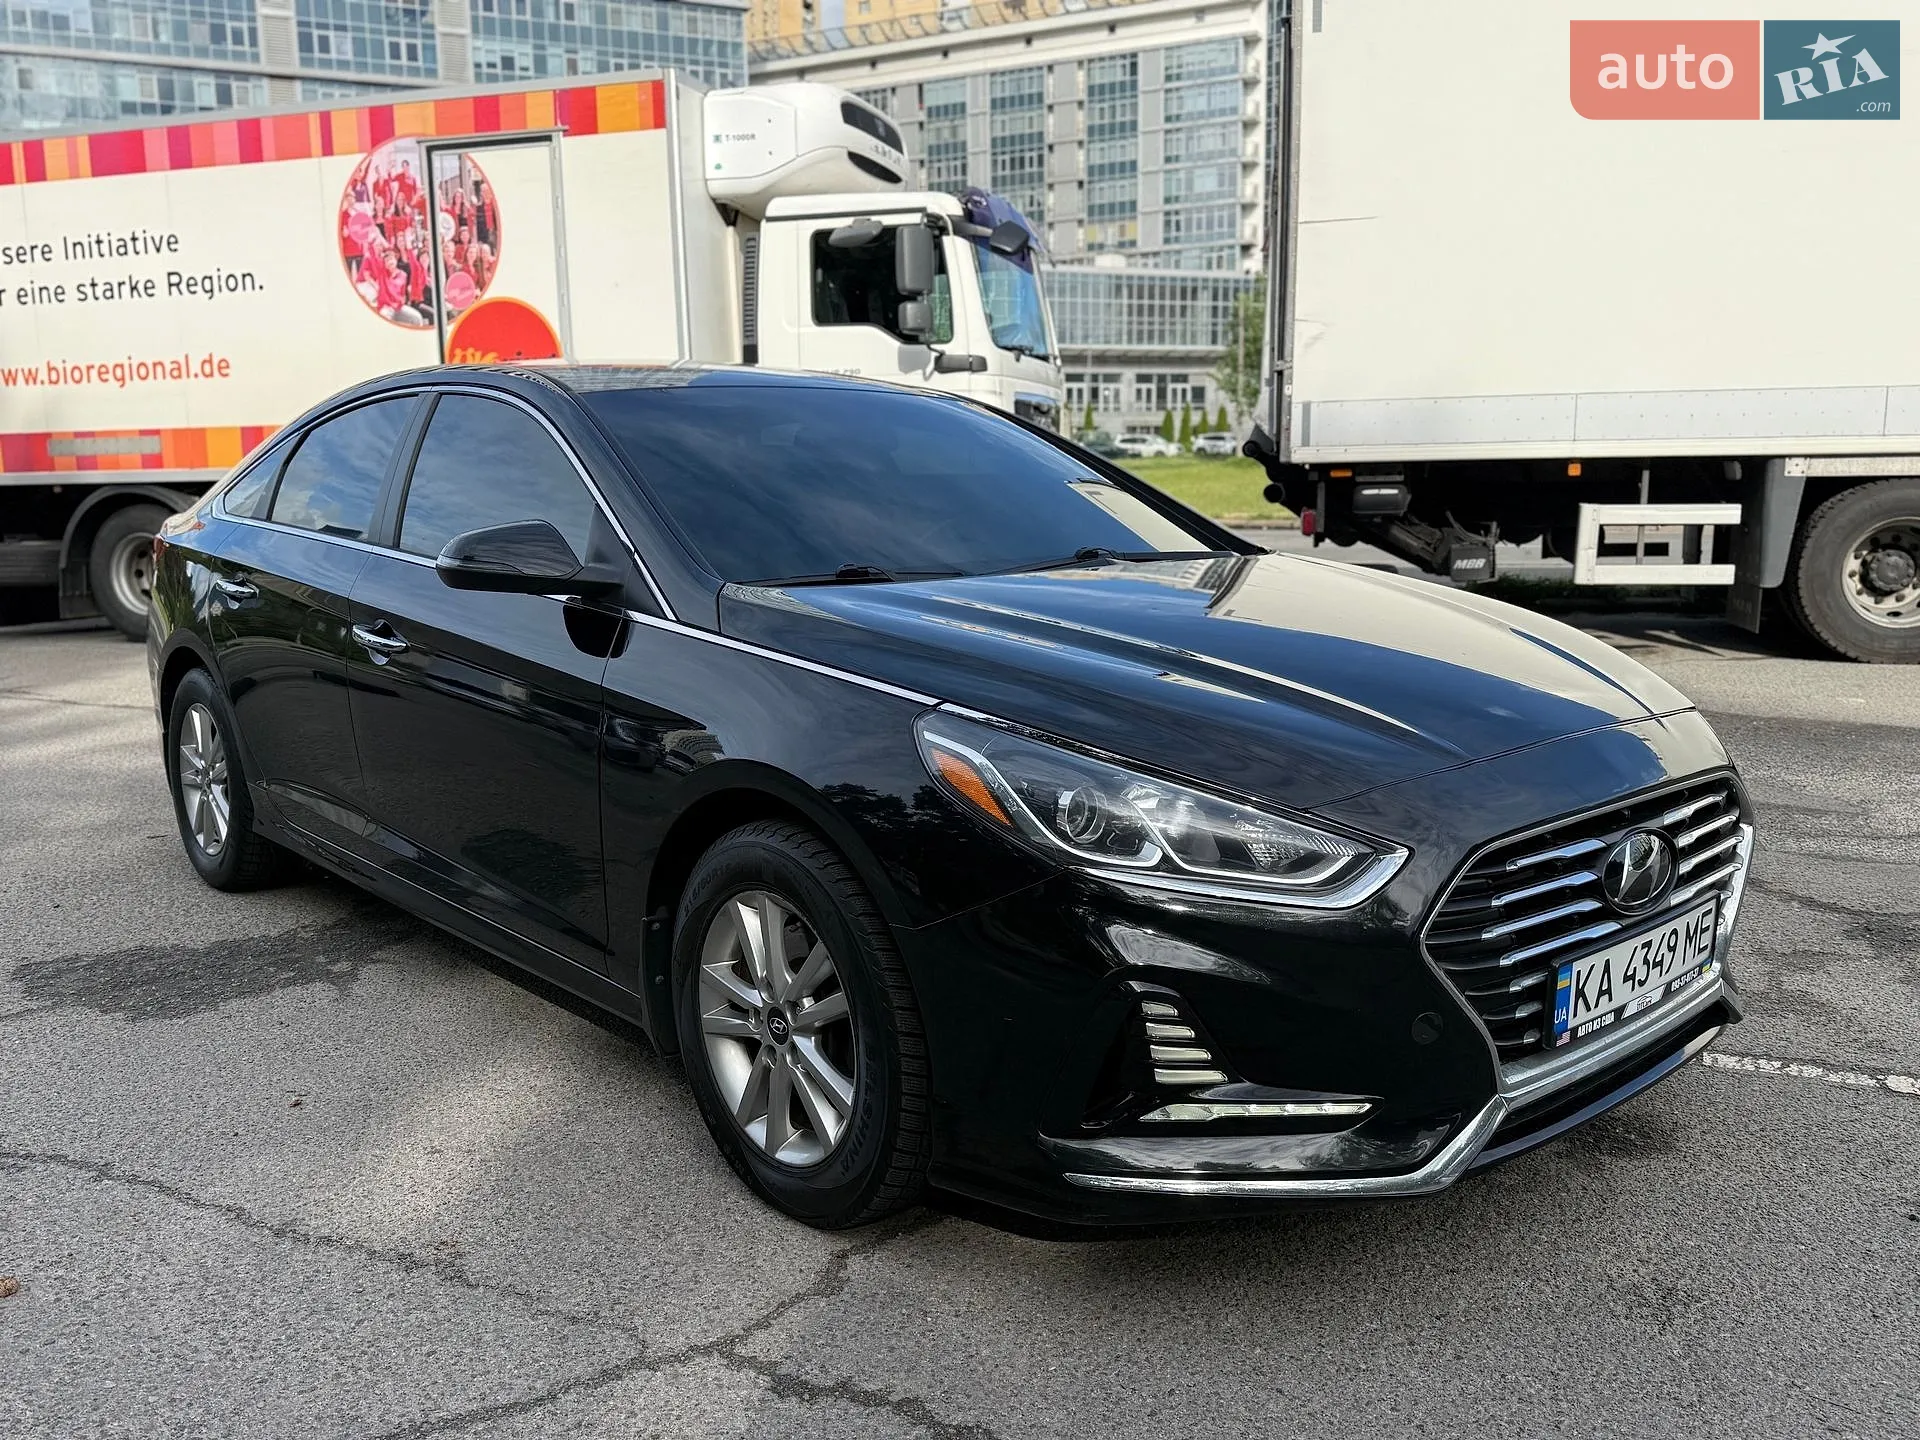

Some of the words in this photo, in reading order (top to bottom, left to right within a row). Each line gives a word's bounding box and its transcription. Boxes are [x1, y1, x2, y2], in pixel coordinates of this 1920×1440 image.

[2, 242, 53, 265] sere
[63, 230, 180, 261] Initiative
[17, 280, 66, 305] eine
[76, 274, 156, 302] starke
[167, 268, 265, 300] Region.
[0, 352, 231, 388] ww.bioregional.de
[1572, 957, 1614, 1019] KA
[1622, 927, 1679, 992] 4349
[1681, 909, 1713, 966] ME
[1554, 1007, 1568, 1024] UA
